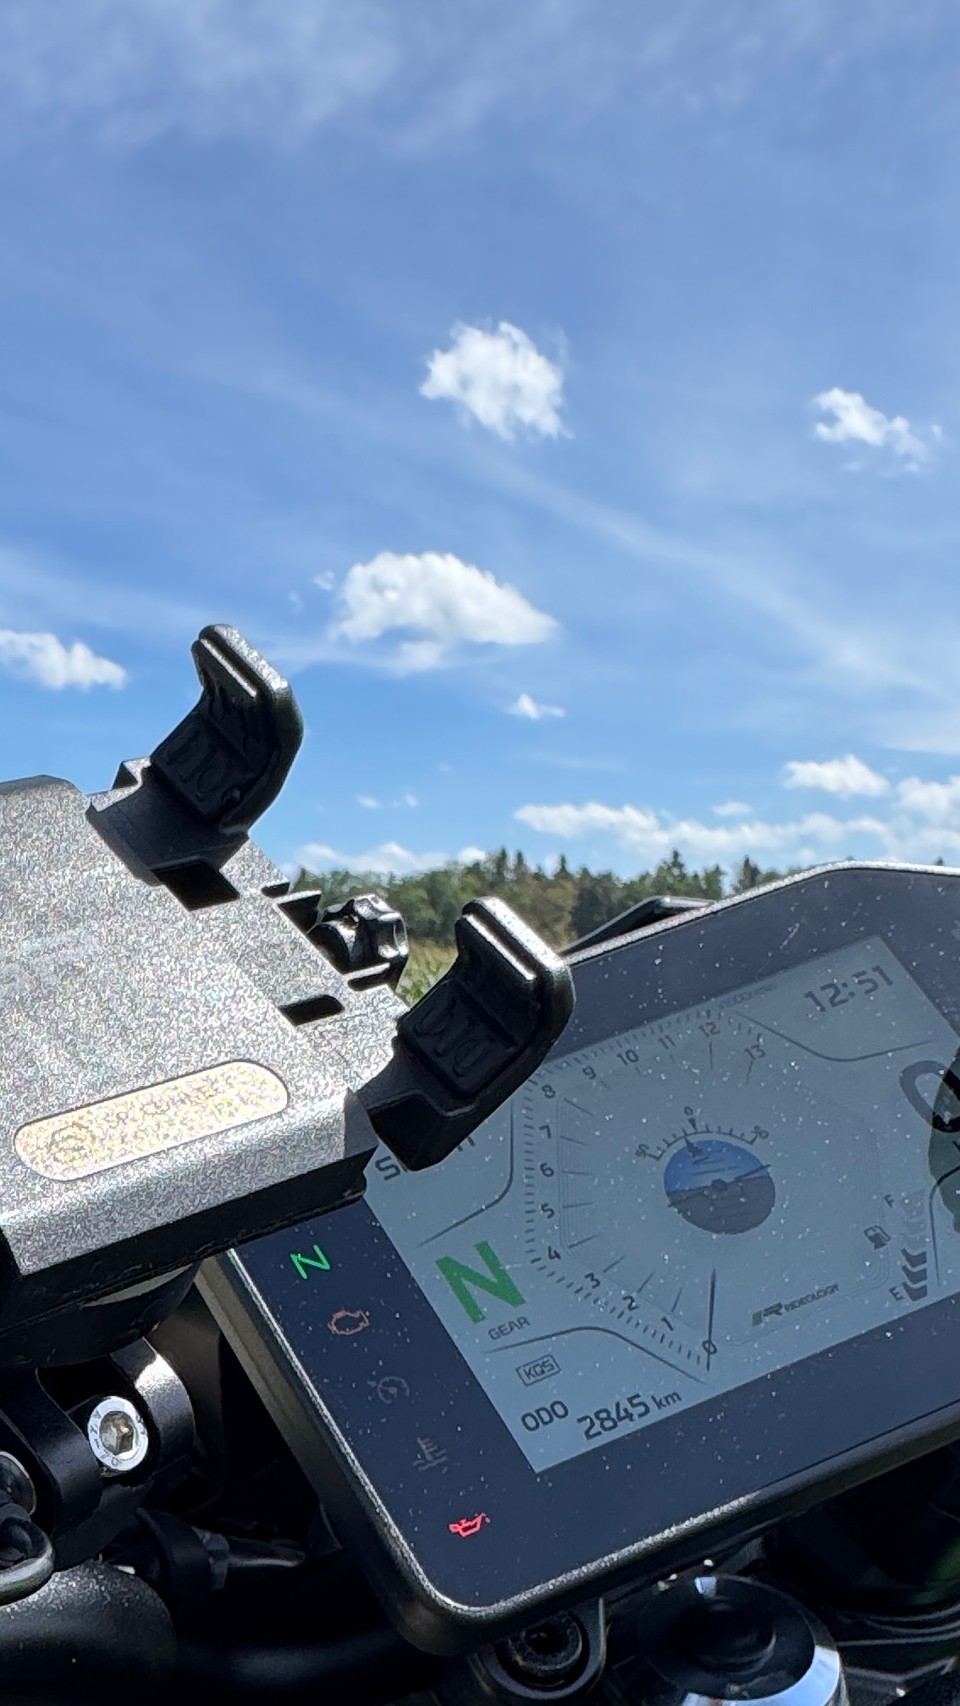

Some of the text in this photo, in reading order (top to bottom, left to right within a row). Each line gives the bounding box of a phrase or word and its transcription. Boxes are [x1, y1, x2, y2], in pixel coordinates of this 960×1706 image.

[804, 964, 893, 1012] 12:51
[698, 1021, 721, 1039] 12
[657, 1034, 676, 1050] 11
[615, 1049, 640, 1067] 10
[743, 1043, 767, 1061] 13
[581, 1064, 597, 1081] 9
[541, 1084, 557, 1100] 8
[539, 1124, 552, 1140] 7
[539, 1162, 555, 1178] 6
[883, 1193, 895, 1209] F
[540, 1202, 555, 1219] 5
[547, 1246, 562, 1260] 4
[290, 1244, 331, 1280] N
[436, 1240, 526, 1324] N
[584, 1272, 601, 1288] 3
[889, 1286, 905, 1301] E
[622, 1295, 638, 1311] 2
[488, 1316, 531, 1341] GEAR
[660, 1315, 674, 1331] 1
[702, 1340, 717, 1354] 0
[524, 1359, 555, 1381] KQS
[520, 1390, 682, 1440] ODO 2845 km
